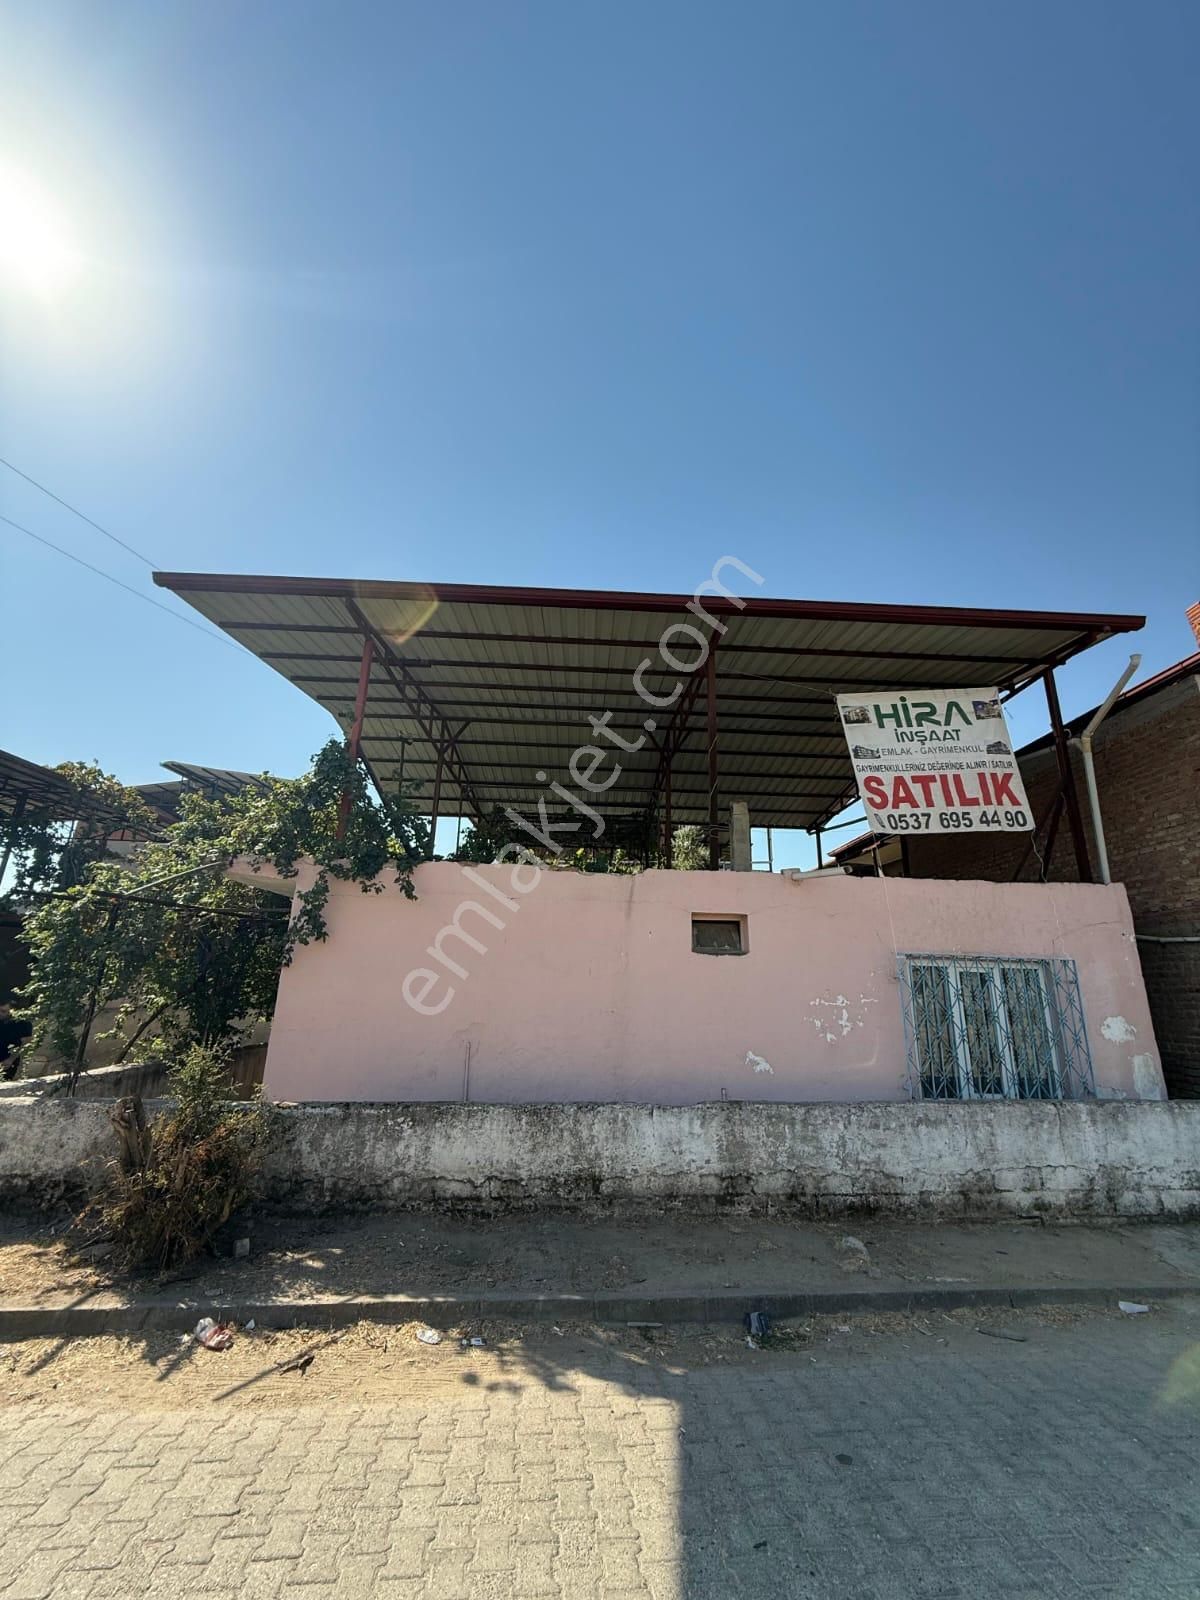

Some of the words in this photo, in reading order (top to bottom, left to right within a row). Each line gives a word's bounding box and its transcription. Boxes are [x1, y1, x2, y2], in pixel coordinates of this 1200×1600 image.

[894, 729, 961, 744] İNŞAAT
[881, 746, 913, 756] EMLAK
[919, 744, 985, 755] GAYRİMENKUL
[927, 761, 965, 771] DEĞERİNDE
[966, 761, 987, 770] ALINIR
[991, 761, 1014, 769] SATILIR
[863, 772, 1022, 810] SATILIK
[887, 812, 931, 830] 0537
[939, 811, 973, 829] 695
[979, 810, 1002, 827] 44
[1004, 810, 1028, 828] 90
